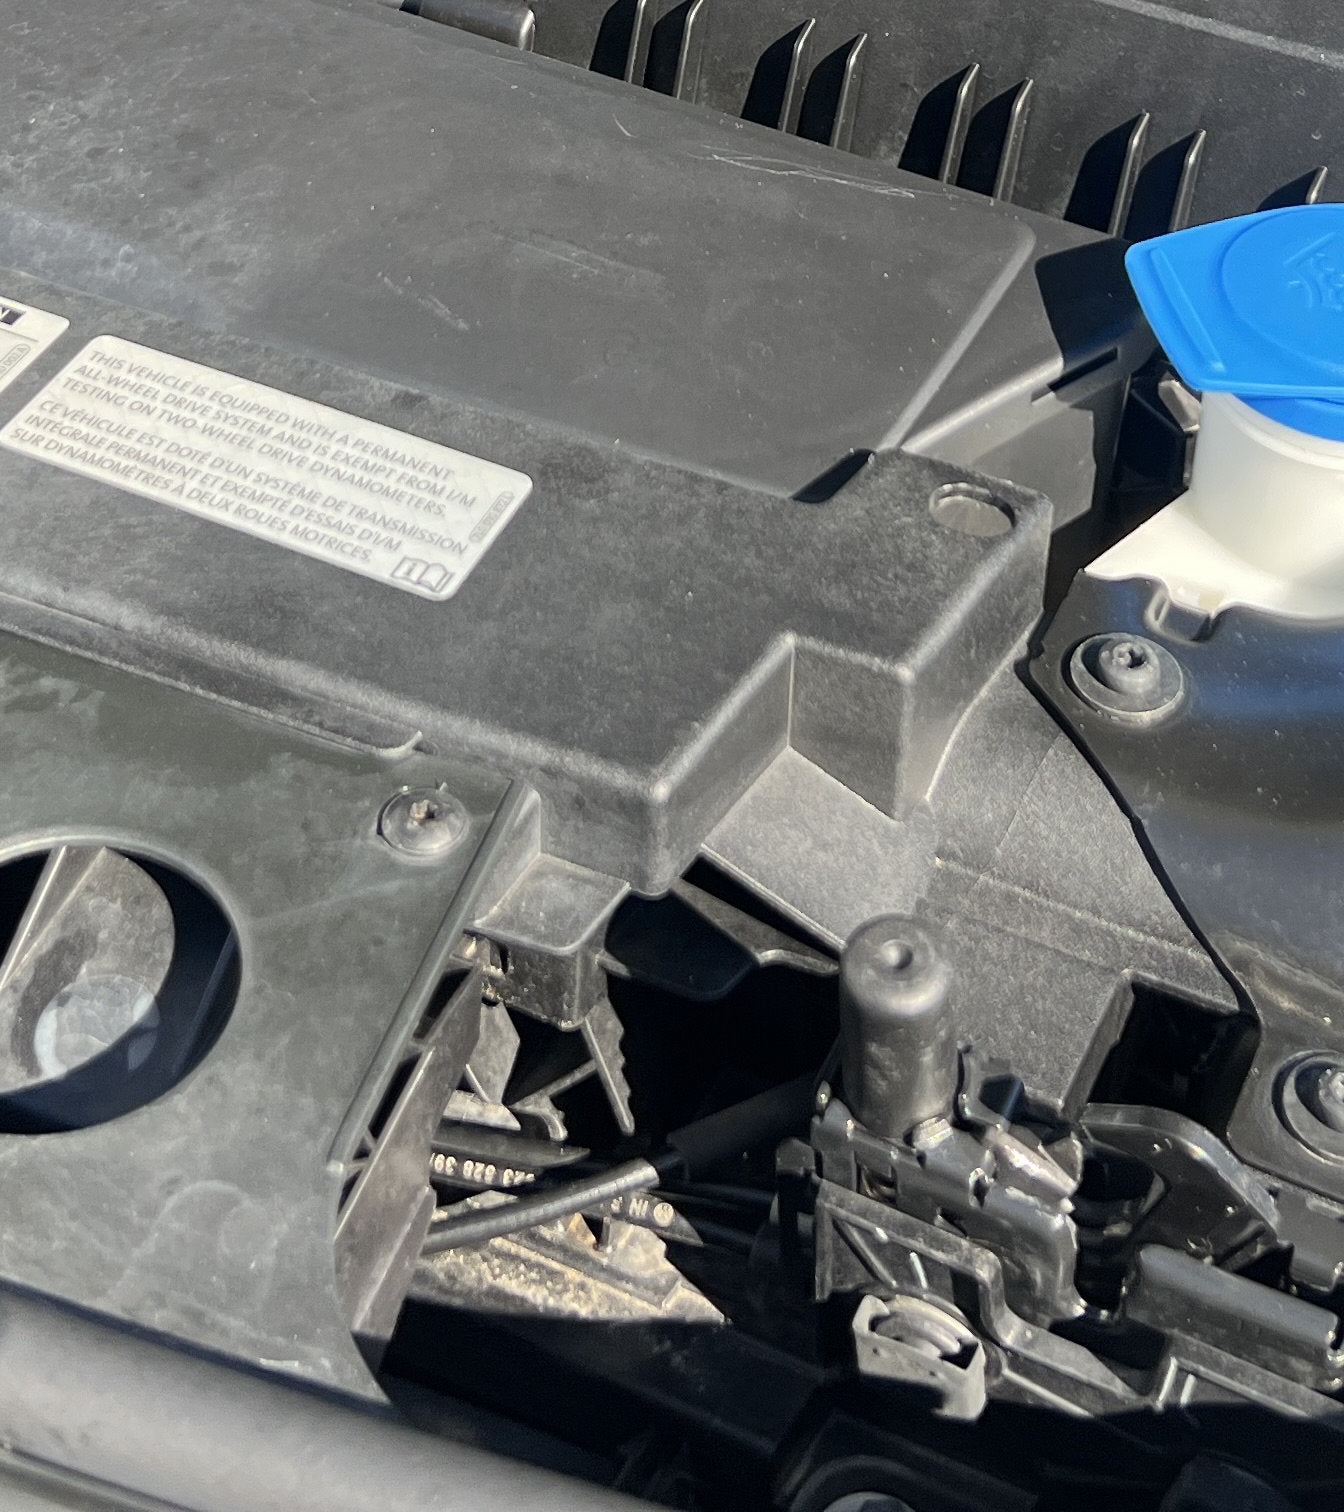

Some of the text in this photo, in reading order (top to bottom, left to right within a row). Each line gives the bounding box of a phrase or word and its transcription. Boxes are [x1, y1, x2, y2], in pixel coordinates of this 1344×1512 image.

[24, 412, 402, 551] INTÉGRALE PERMANENT ET EXEMPTÉ D'ESSAIS D'I/M
[39, 398, 469, 554] CE VÉHICULE EST DOTÉ D'UN SYSTÈME DE TRANSMISSION
[60, 376, 130, 406] TESTING
[127, 399, 158, 415] ON
[155, 408, 259, 450] TWO-WHEEL
[256, 443, 309, 468] DRIVE
[308, 461, 451, 517] DYNAMOMETERS.
[74, 363, 478, 506] ALL-WHEEL DRIVE SYSTEM AND IS EXEMPT FROM I/M
[87, 350, 456, 480] THIS VEHICLE IS EQUIPPED WITH A PERMANENT
[10, 427, 376, 562] SUR DYNAMOMÈTRES À DEUX ROUES MOTRICES.
